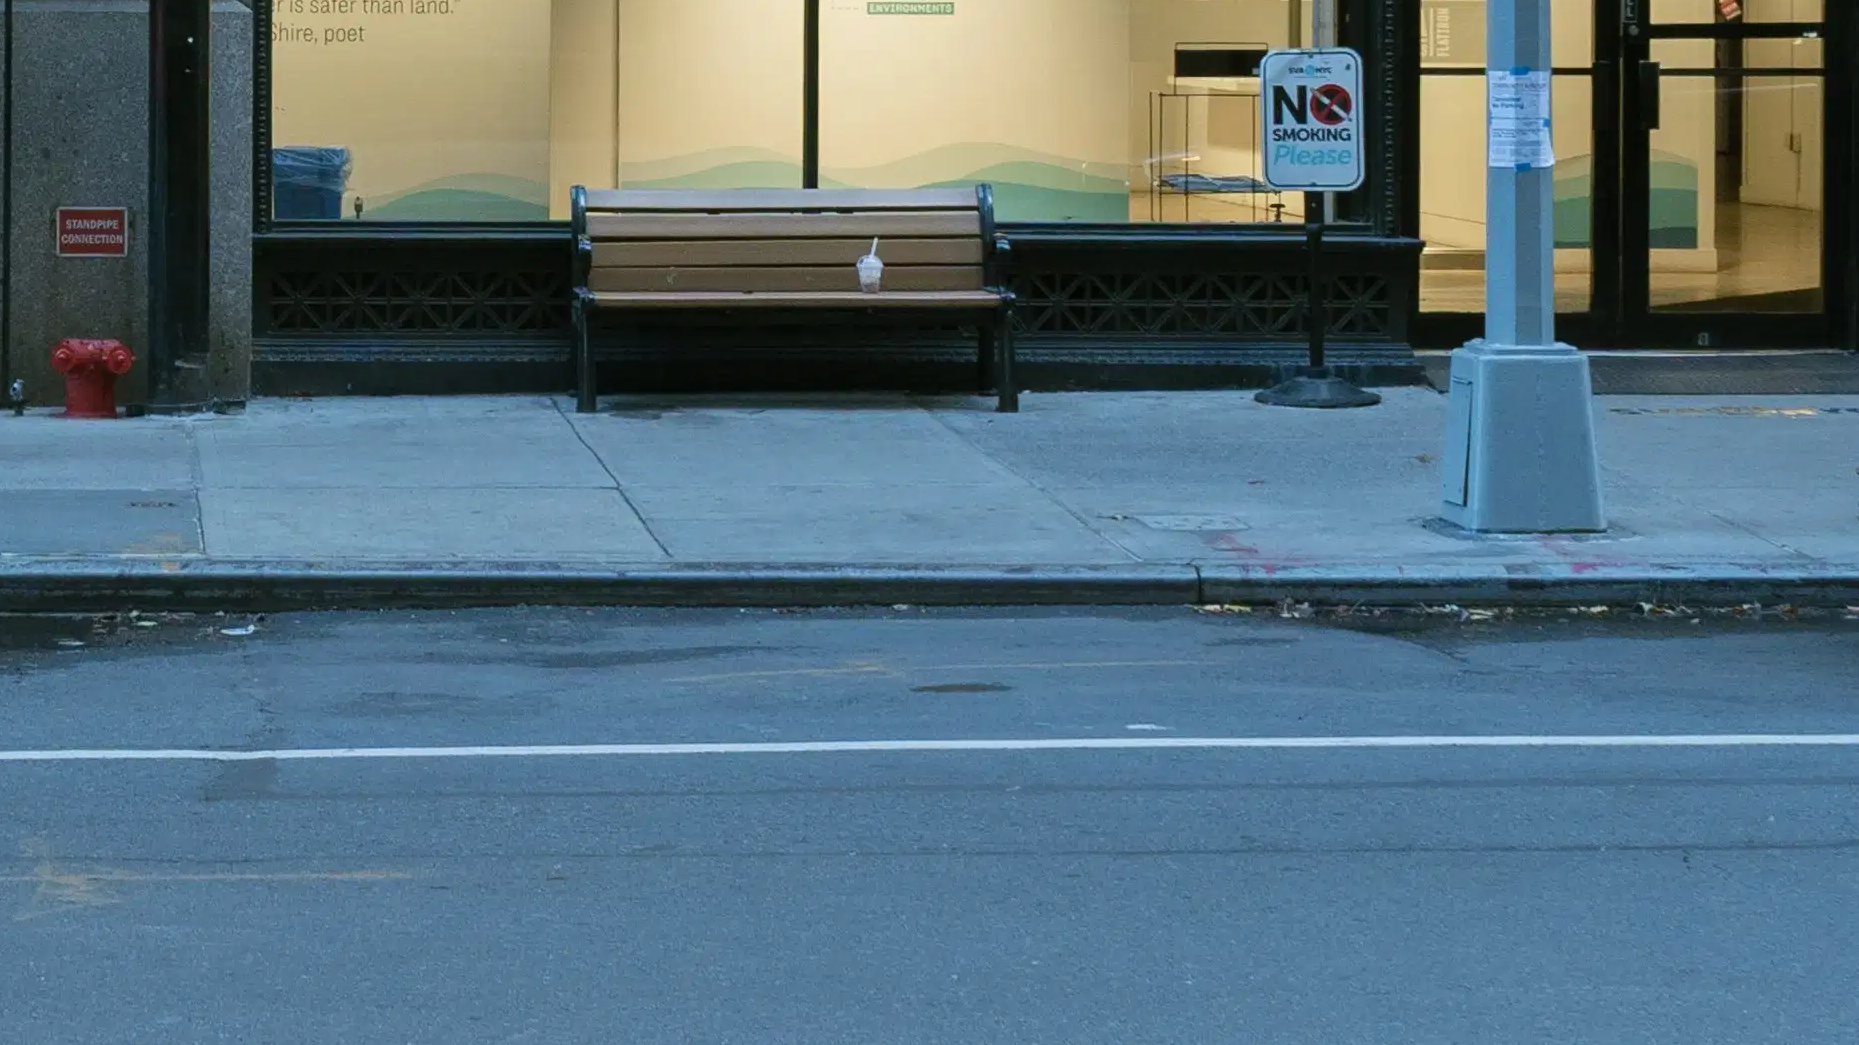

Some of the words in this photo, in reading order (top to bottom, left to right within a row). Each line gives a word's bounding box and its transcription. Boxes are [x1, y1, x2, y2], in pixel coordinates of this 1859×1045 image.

[868, 3, 953, 14] ENVIRONMENTS
[323, 25, 365, 46] poet
[1272, 128, 1352, 142] SMOKING
[1273, 144, 1352, 166] Please
[65, 219, 120, 230] STANDPIPE
[61, 234, 123, 245] CONNECTION
